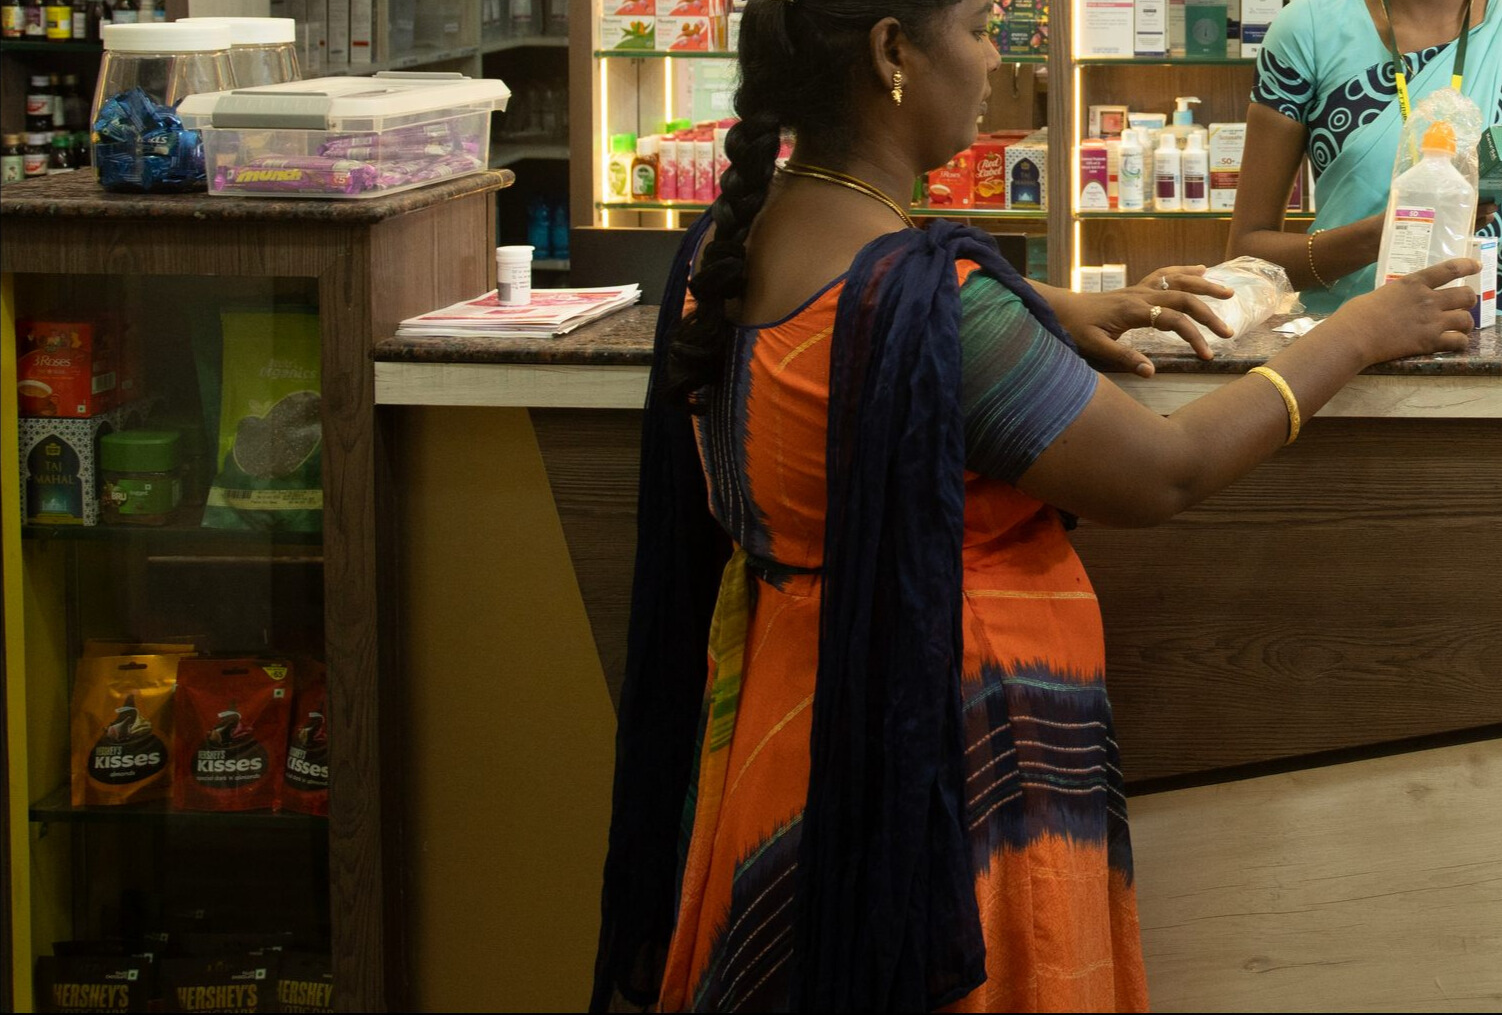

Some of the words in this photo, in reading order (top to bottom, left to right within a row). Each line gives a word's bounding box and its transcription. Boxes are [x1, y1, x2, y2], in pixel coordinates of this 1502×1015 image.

[137, 135, 168, 145] HLLS
[982, 159, 999, 169] Red
[976, 168, 1003, 179] Label
[44, 462, 62, 473] TAJ
[34, 474, 74, 485] MAHAL
[111, 491, 127, 502] BRU
[277, 979, 333, 1007] HERSHEY
